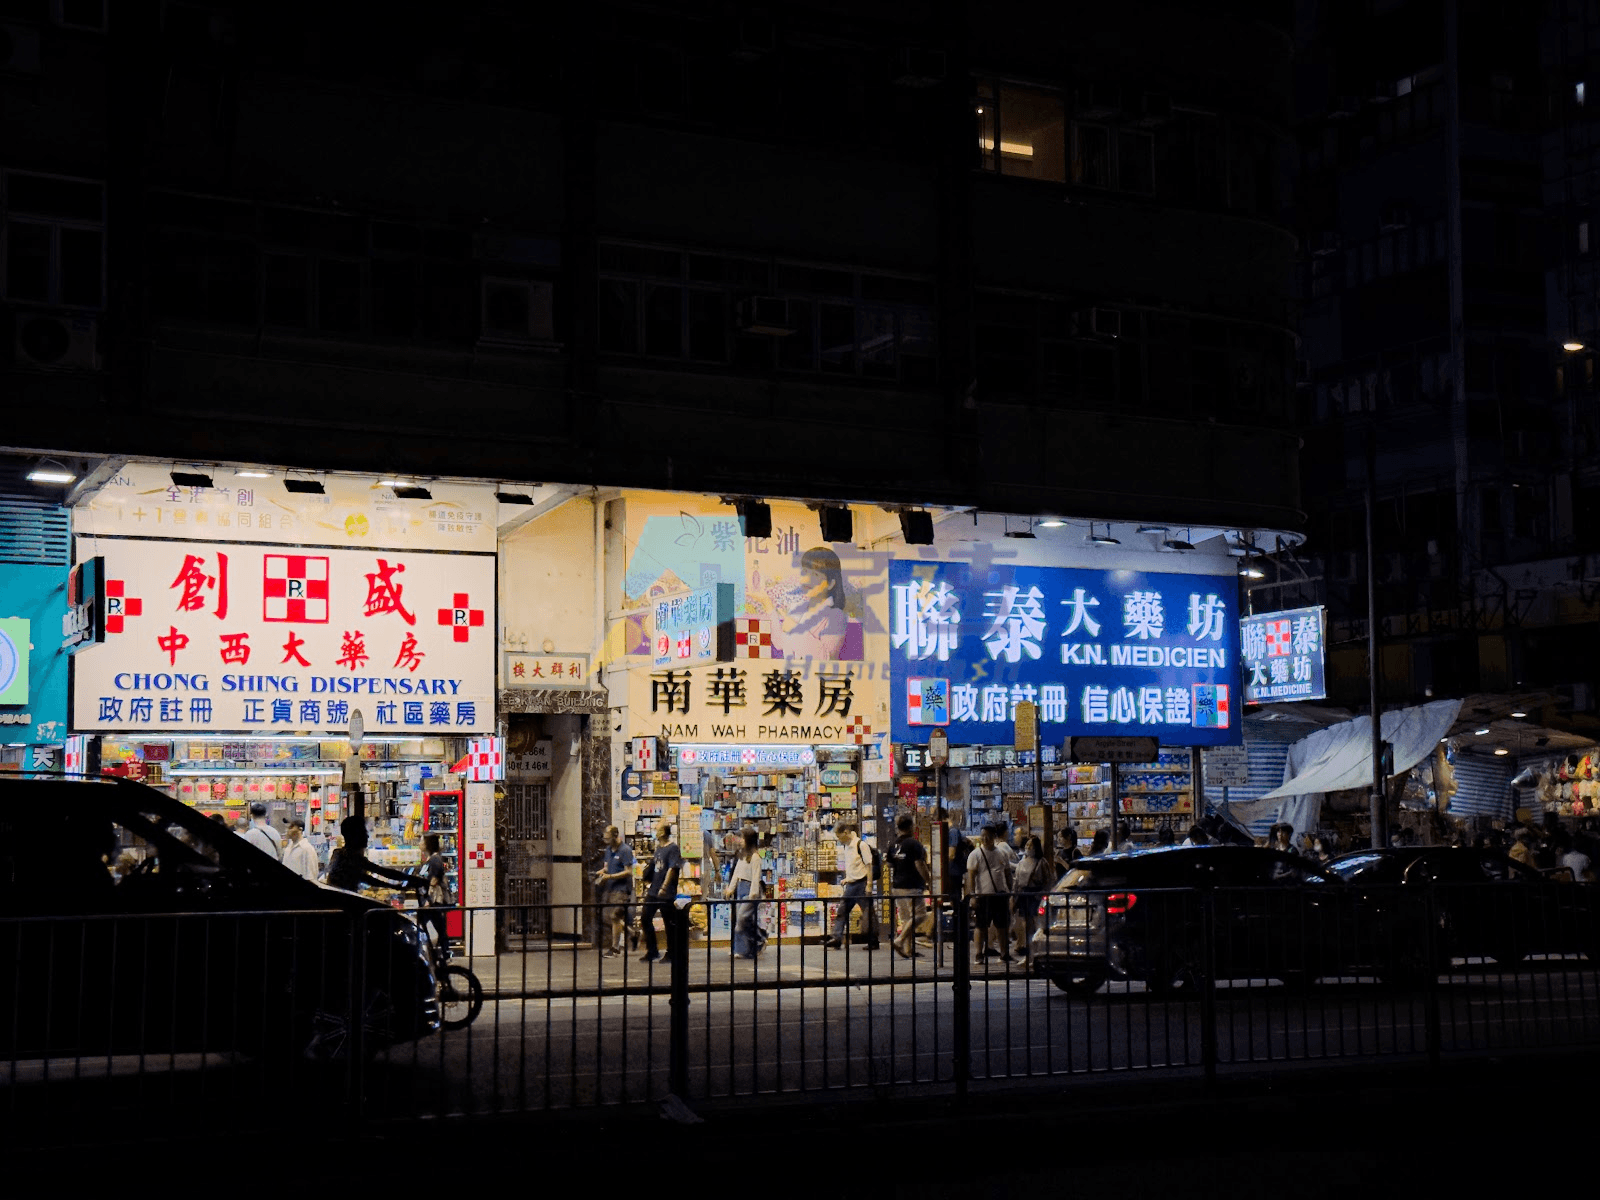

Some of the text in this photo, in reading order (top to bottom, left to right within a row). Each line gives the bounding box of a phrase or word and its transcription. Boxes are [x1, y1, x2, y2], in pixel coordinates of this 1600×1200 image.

[157, 625, 426, 673] 中西大藥房
[114, 673, 463, 696] CHONG SHING DISPENSARY
[1249, 656, 1312, 686] 大藥坊
[557, 698, 604, 707] BUILDING
[651, 668, 855, 718] 南華藥房
[1081, 686, 1192, 725] 信心保證
[98, 697, 475, 726] 政府註冊 正貨商號 社區藥房
[661, 724, 844, 739] NAM WAH PHARMACY
